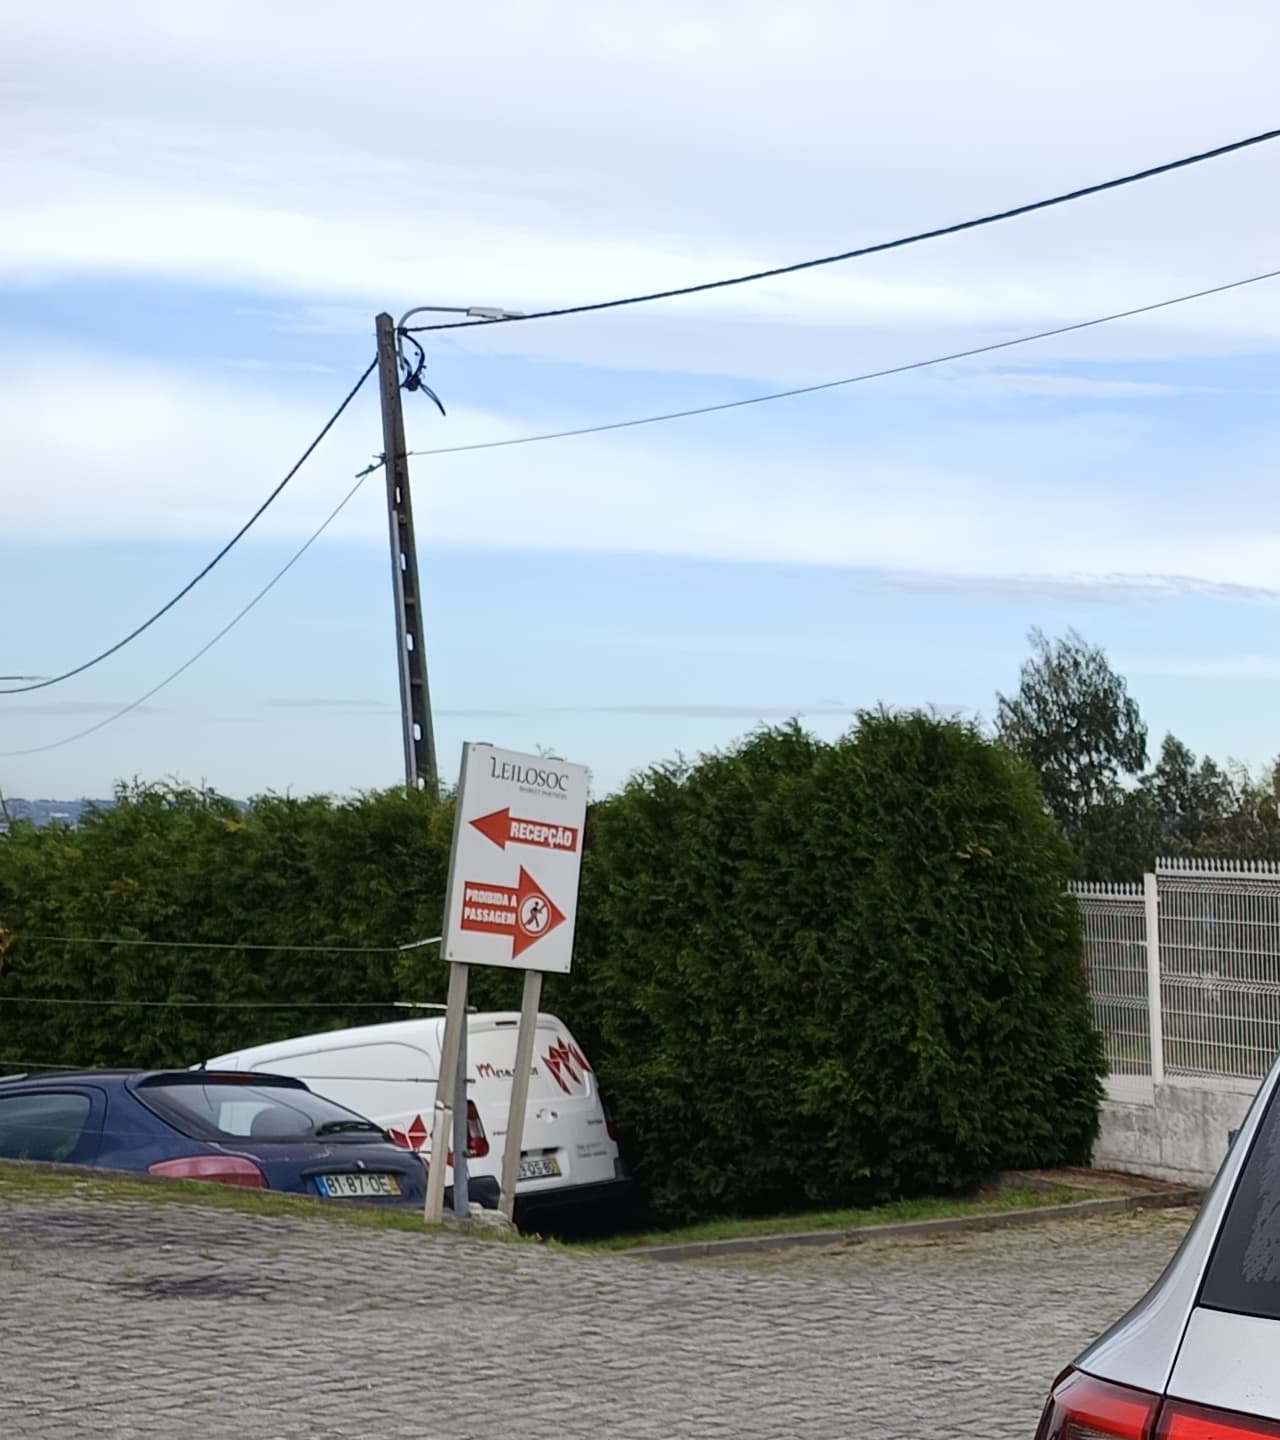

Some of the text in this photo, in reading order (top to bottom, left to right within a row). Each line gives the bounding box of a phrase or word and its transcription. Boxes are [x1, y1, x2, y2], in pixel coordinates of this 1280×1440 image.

[490, 756, 569, 792] LEILOSOC
[510, 821, 573, 848] RECEPÇÃO
[464, 906, 516, 926] PASSAGEM
